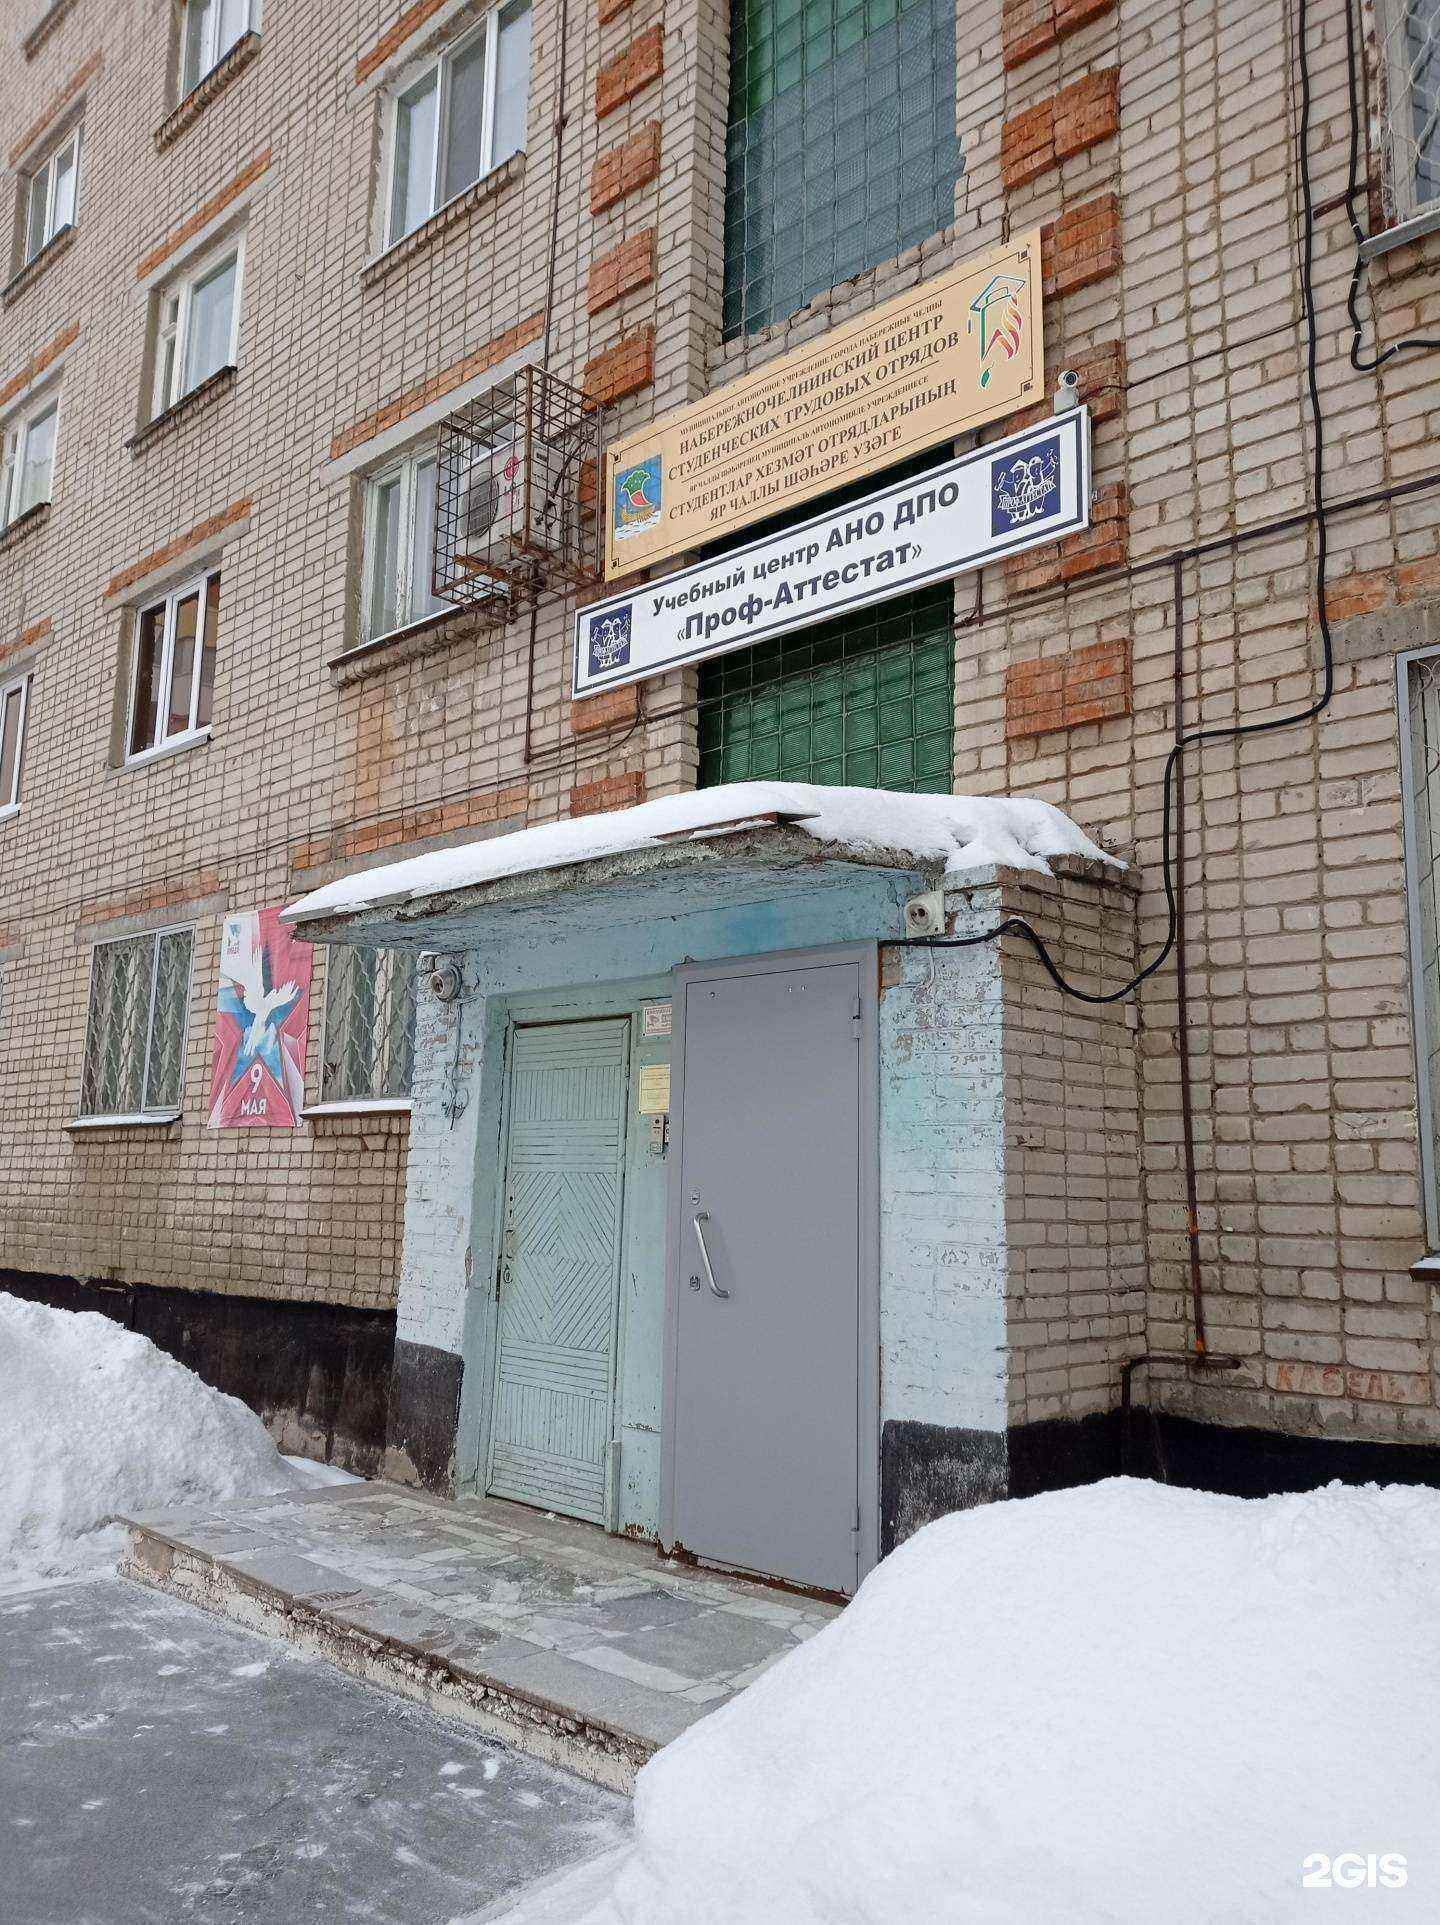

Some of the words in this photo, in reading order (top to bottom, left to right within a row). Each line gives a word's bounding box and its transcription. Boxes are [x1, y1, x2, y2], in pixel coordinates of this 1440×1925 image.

[667, 414, 781, 482] СТУДЕНЧЕСКИХ
[783, 371, 872, 425] ТРУДОВЫХ
[875, 330, 960, 382] ОТРЯДОВ
[679, 341, 880, 456] НАБЕРЕЖНОЧЕЛНИНСКИЙ
[883, 314, 944, 354] ЦЕНТР
[668, 472, 754, 521] СТУДЕНТЛАР
[755, 444, 815, 480] ХЕЗМӘТ
[817, 378, 958, 454] ОТРЯДЛАРЫНЫҢ
[709, 504, 727, 522] ЯР
[730, 478, 781, 512] ЧАЛЛЫ
[783, 450, 849, 488] ШӘҺӘРЕ
[852, 425, 903, 460] УЗӘГЕ
[652, 565, 746, 617] Учебный
[752, 541, 820, 580] центр
[825, 510, 885, 553] АНО
[893, 480, 960, 532] ДПО
[676, 541, 923, 642] «Проф-Аттестат»
[240, 1098, 267, 1116] МАЯ
[250, 1063, 263, 1094] 9
